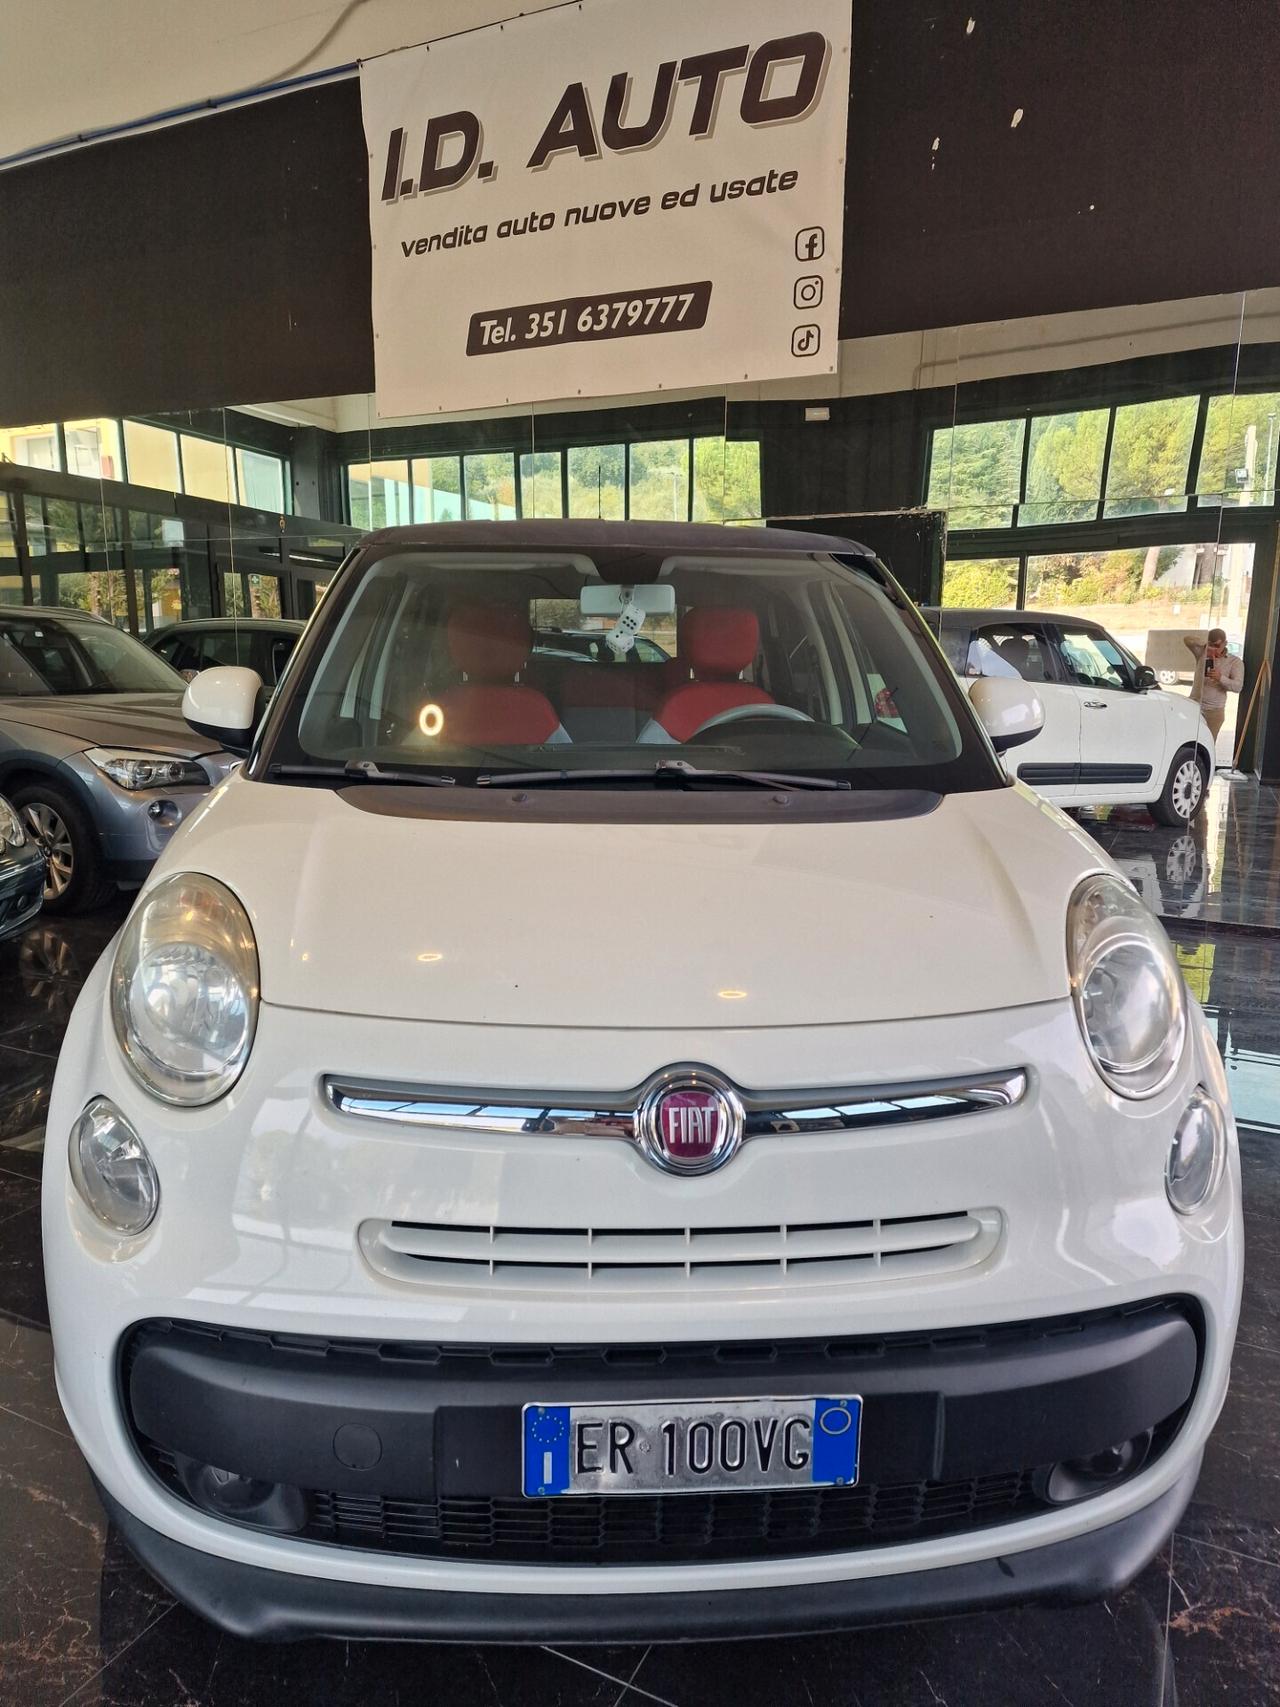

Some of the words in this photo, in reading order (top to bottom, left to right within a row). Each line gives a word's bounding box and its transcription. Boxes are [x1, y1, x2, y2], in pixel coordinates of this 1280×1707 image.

[381, 110, 497, 205] I.D.
[526, 31, 832, 173] AUTO
[401, 224, 488, 257] vendita
[496, 211, 555, 238] auto
[564, 197, 650, 227] nuove
[660, 183, 700, 211] ed
[709, 169, 799, 202] usate
[480, 318, 516, 347] Tel.
[525, 308, 567, 340] 351
[576, 293, 695, 333] 6379777
[668, 1106, 715, 1144] FIAT
[575, 1421, 635, 1474] ER
